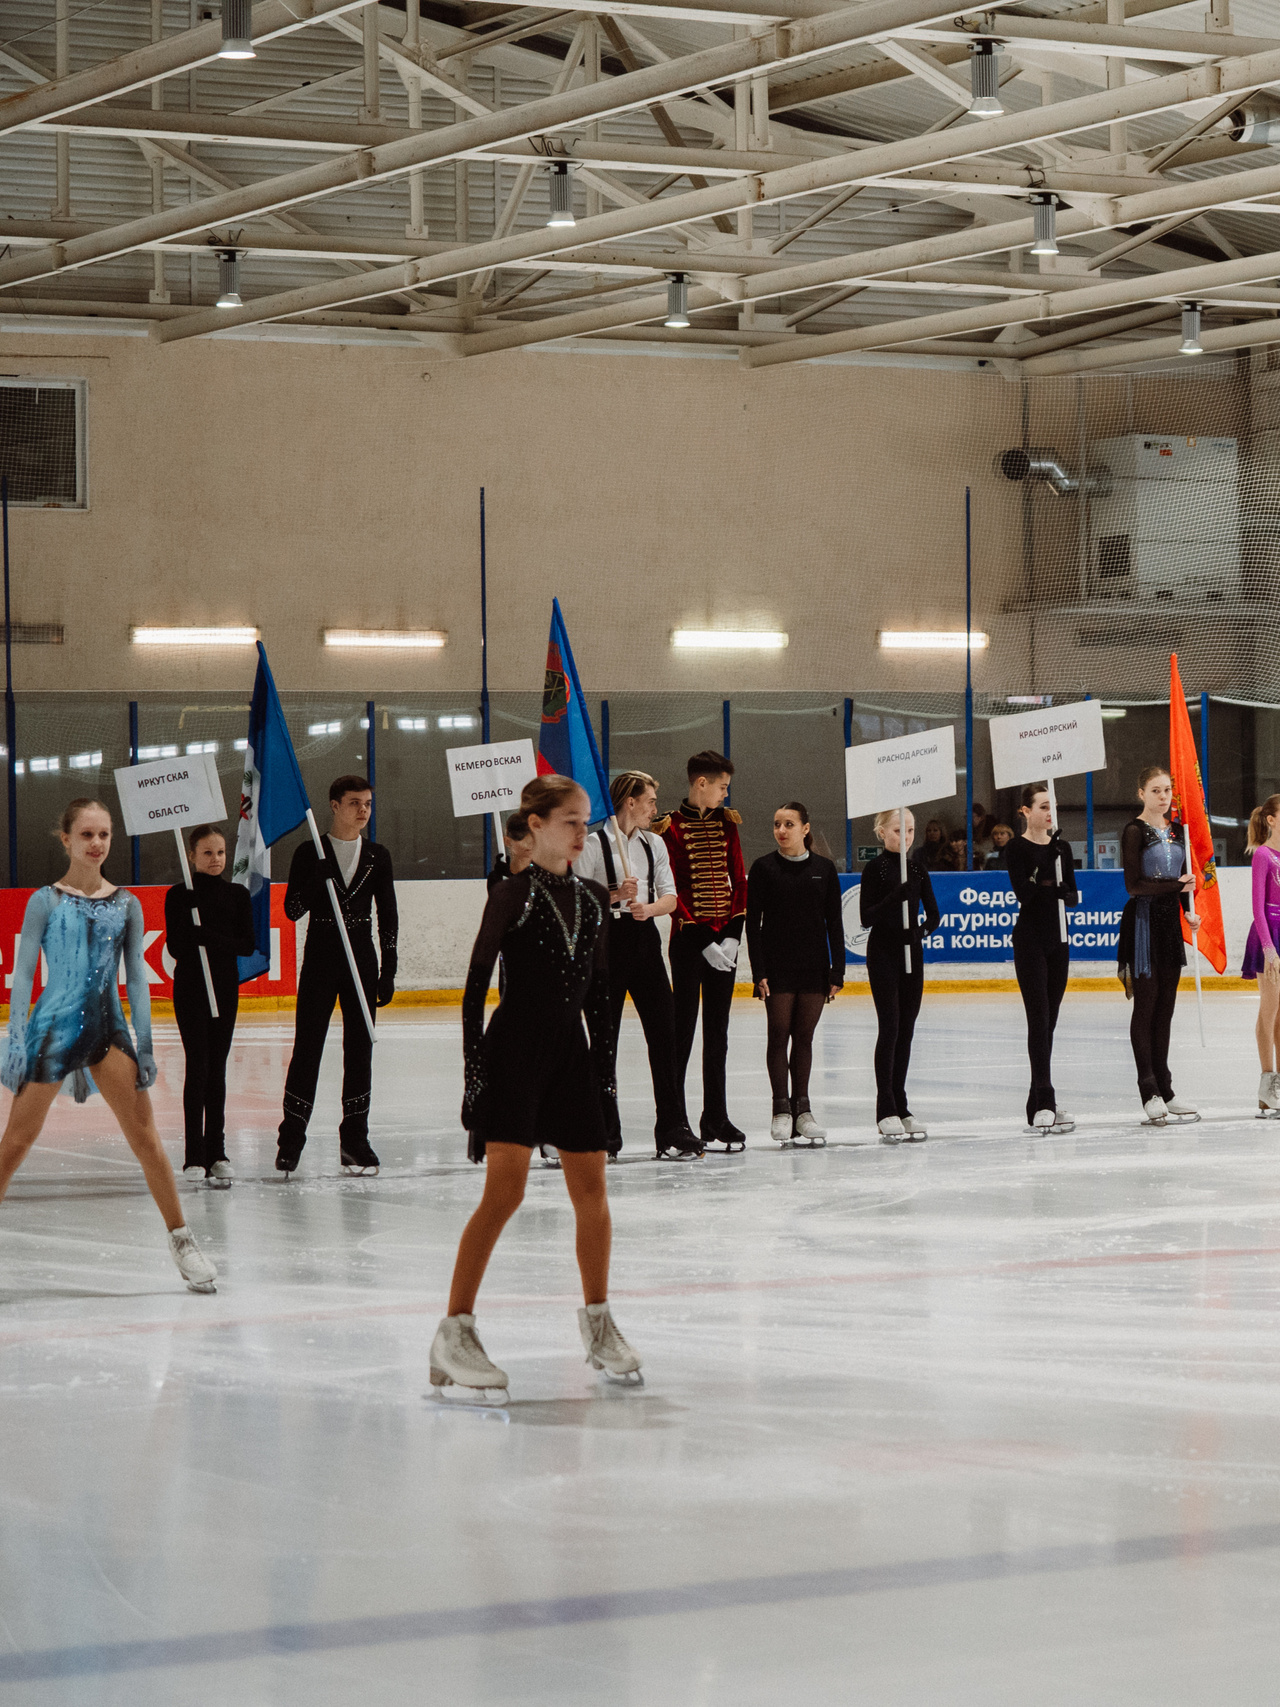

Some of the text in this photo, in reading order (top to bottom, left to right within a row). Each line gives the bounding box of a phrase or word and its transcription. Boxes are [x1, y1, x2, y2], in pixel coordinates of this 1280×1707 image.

[1019, 719, 1078, 740] КРАСНОЯРСКИЙ
[877, 744, 938, 764] КРАСНОДАРСКИЙ
[1042, 751, 1063, 764] КРАЙ
[454, 755, 522, 772] КЕМЕРОВСКАЯ
[137, 770, 189, 789] ИРКУТСКАЯ
[902, 775, 921, 788] КРАЙ
[471, 787, 513, 801] ОБЛАСТЬ
[148, 804, 190, 819] ОБЛАСТЬ
[1066, 911, 1123, 926] тания
[921, 935, 945, 949] на
[951, 934, 1014, 949] коньк
